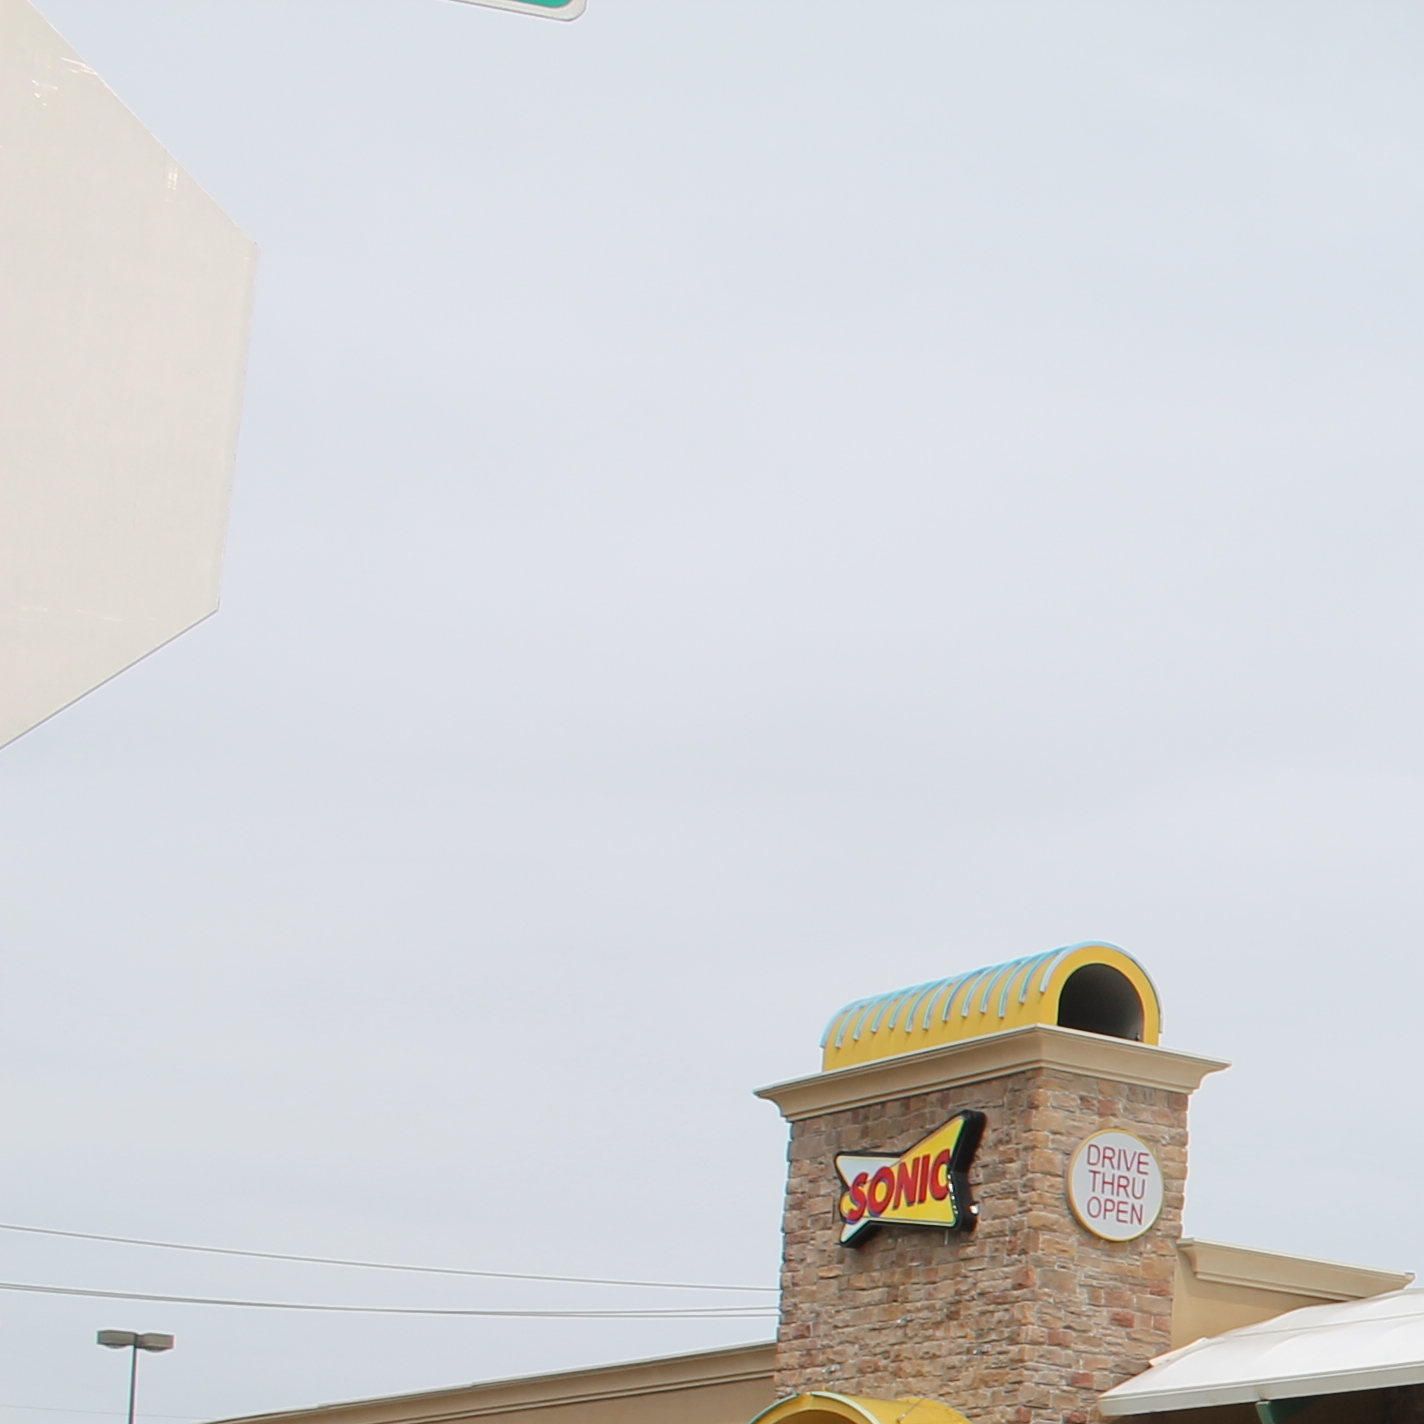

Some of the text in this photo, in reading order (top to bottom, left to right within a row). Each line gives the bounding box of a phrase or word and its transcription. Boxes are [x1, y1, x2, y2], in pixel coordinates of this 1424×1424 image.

[1087, 1144, 1150, 1175] DRIVE
[846, 1148, 951, 1226] SONIC
[1088, 1169, 1146, 1199] THRU
[1086, 1196, 1143, 1225] OPEN
